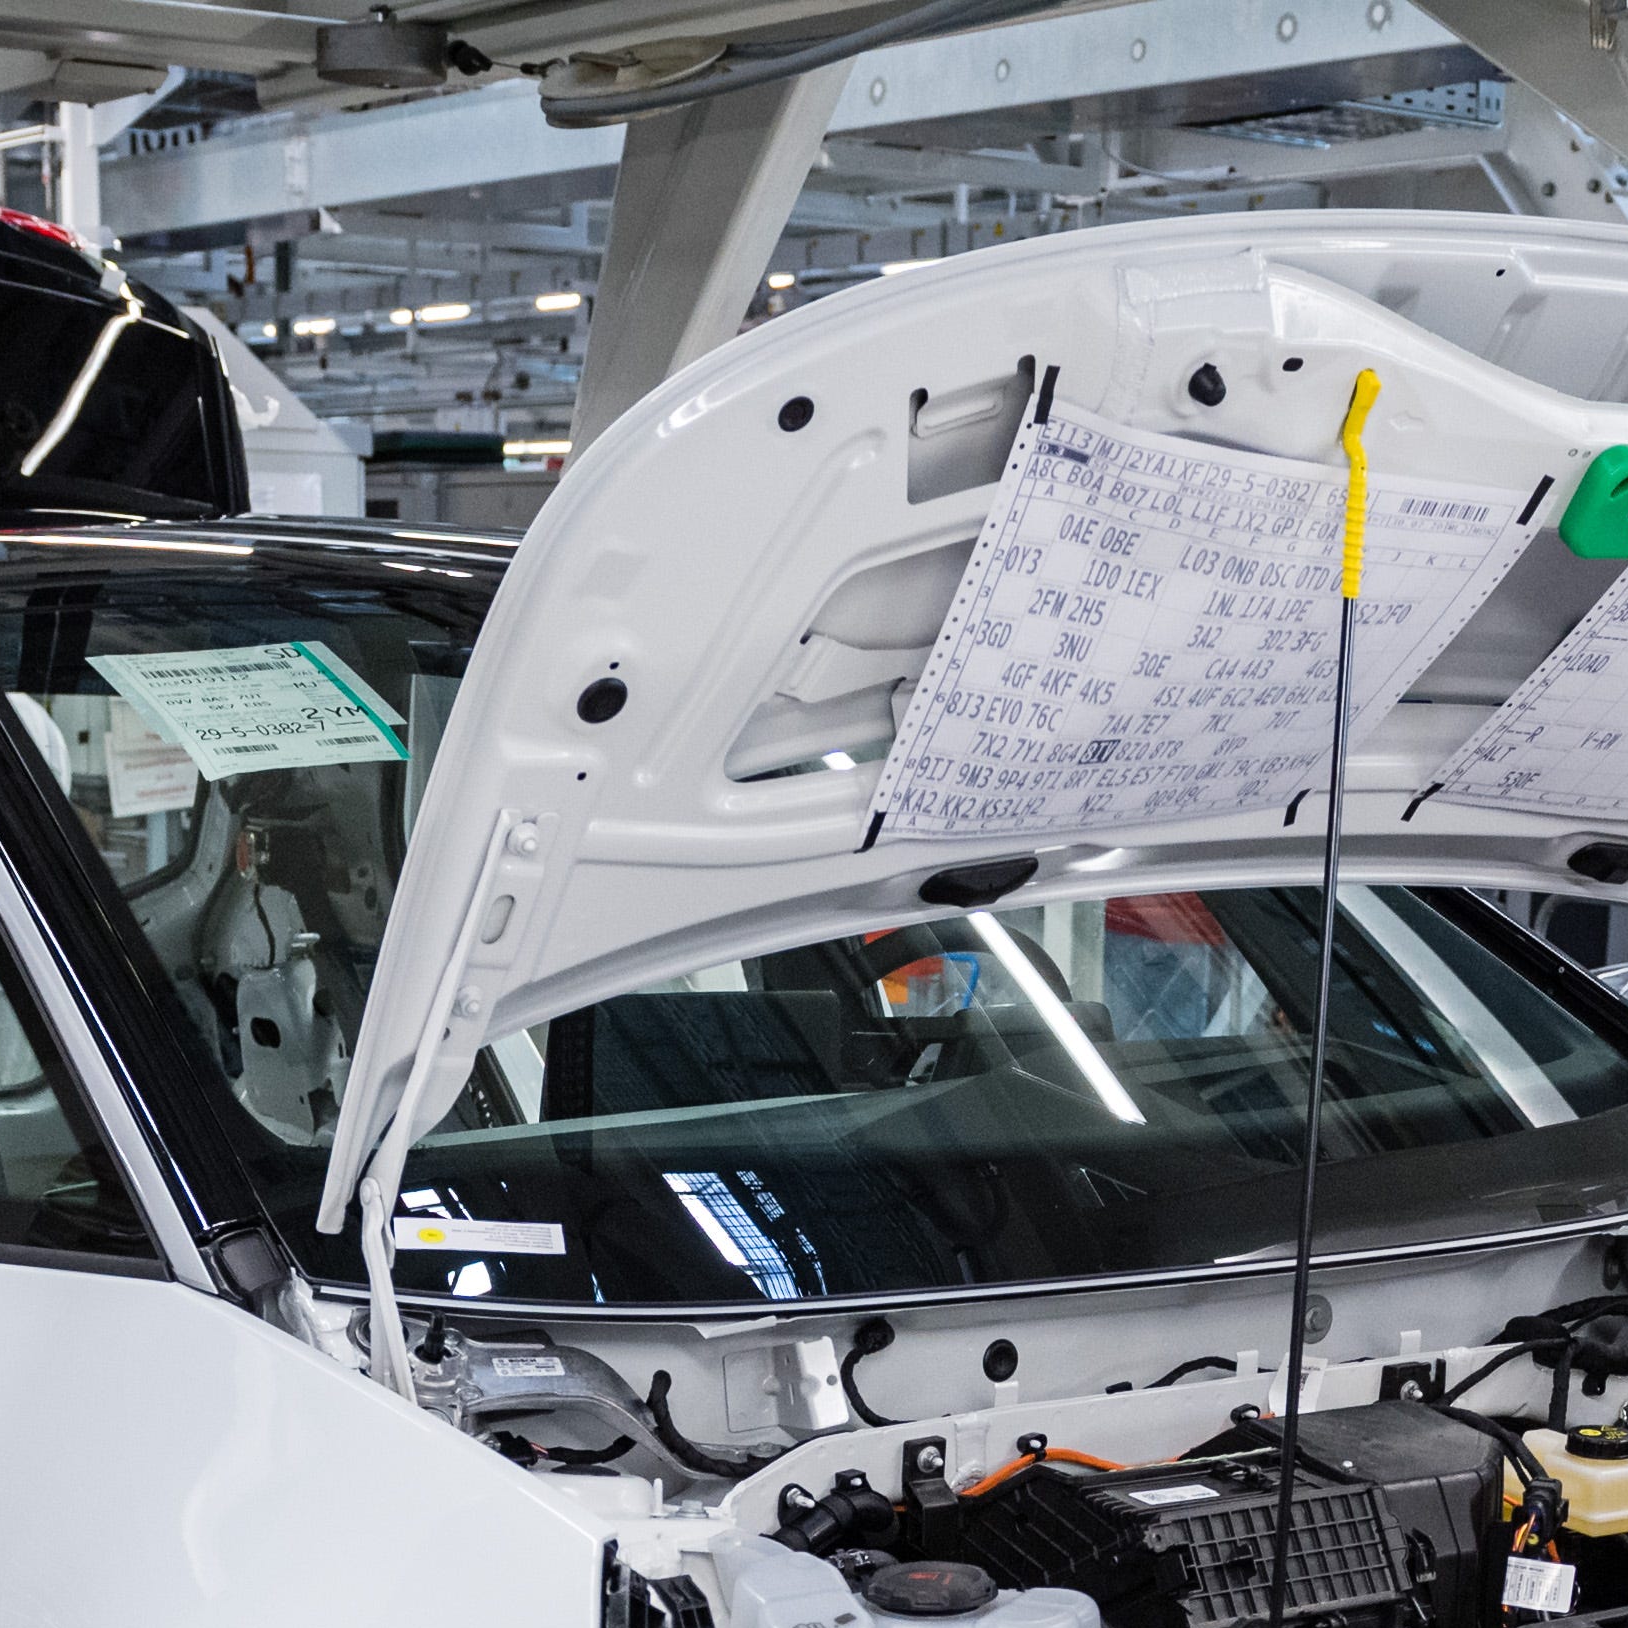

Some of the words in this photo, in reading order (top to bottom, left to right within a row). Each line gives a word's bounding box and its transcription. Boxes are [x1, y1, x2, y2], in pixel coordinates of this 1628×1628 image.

[1040, 419, 1093, 449] E113
[1097, 438, 1124, 461] MJ
[1207, 465, 1311, 502] 29-5-0382
[1027, 456, 1065, 481] A8C
[1231, 509, 1267, 534] 1X2
[1044, 483, 1054, 497] A
[1086, 494, 1099, 506] B
[1122, 569, 1164, 600] 1EX
[1028, 589, 1068, 618] 2FM
[1067, 596, 1106, 626] 2H5
[1187, 624, 1222, 648] 3A2
[264, 647, 301, 659] SD
[1053, 631, 1093, 662] 3NU
[1205, 658, 1240, 680] CA4
[1240, 659, 1275, 680] 4A3
[1002, 661, 1038, 689] 4GF
[1040, 668, 1077, 696] 4KF
[1079, 677, 1116, 705] 4K5
[947, 691, 985, 719] 8J3
[1026, 703, 1063, 732] 76C
[1100, 714, 1133, 735] 7AA
[1134, 714, 1171, 735] 7E7
[195, 720, 325, 741] 29-5-0382=7
[972, 731, 1008, 759] 7X2
[1011, 738, 1045, 764] 7Y1
[956, 762, 994, 790] 9M3
[994, 768, 1030, 791] 9P4
[900, 787, 938, 814] KA2
[940, 793, 977, 819] KK2
